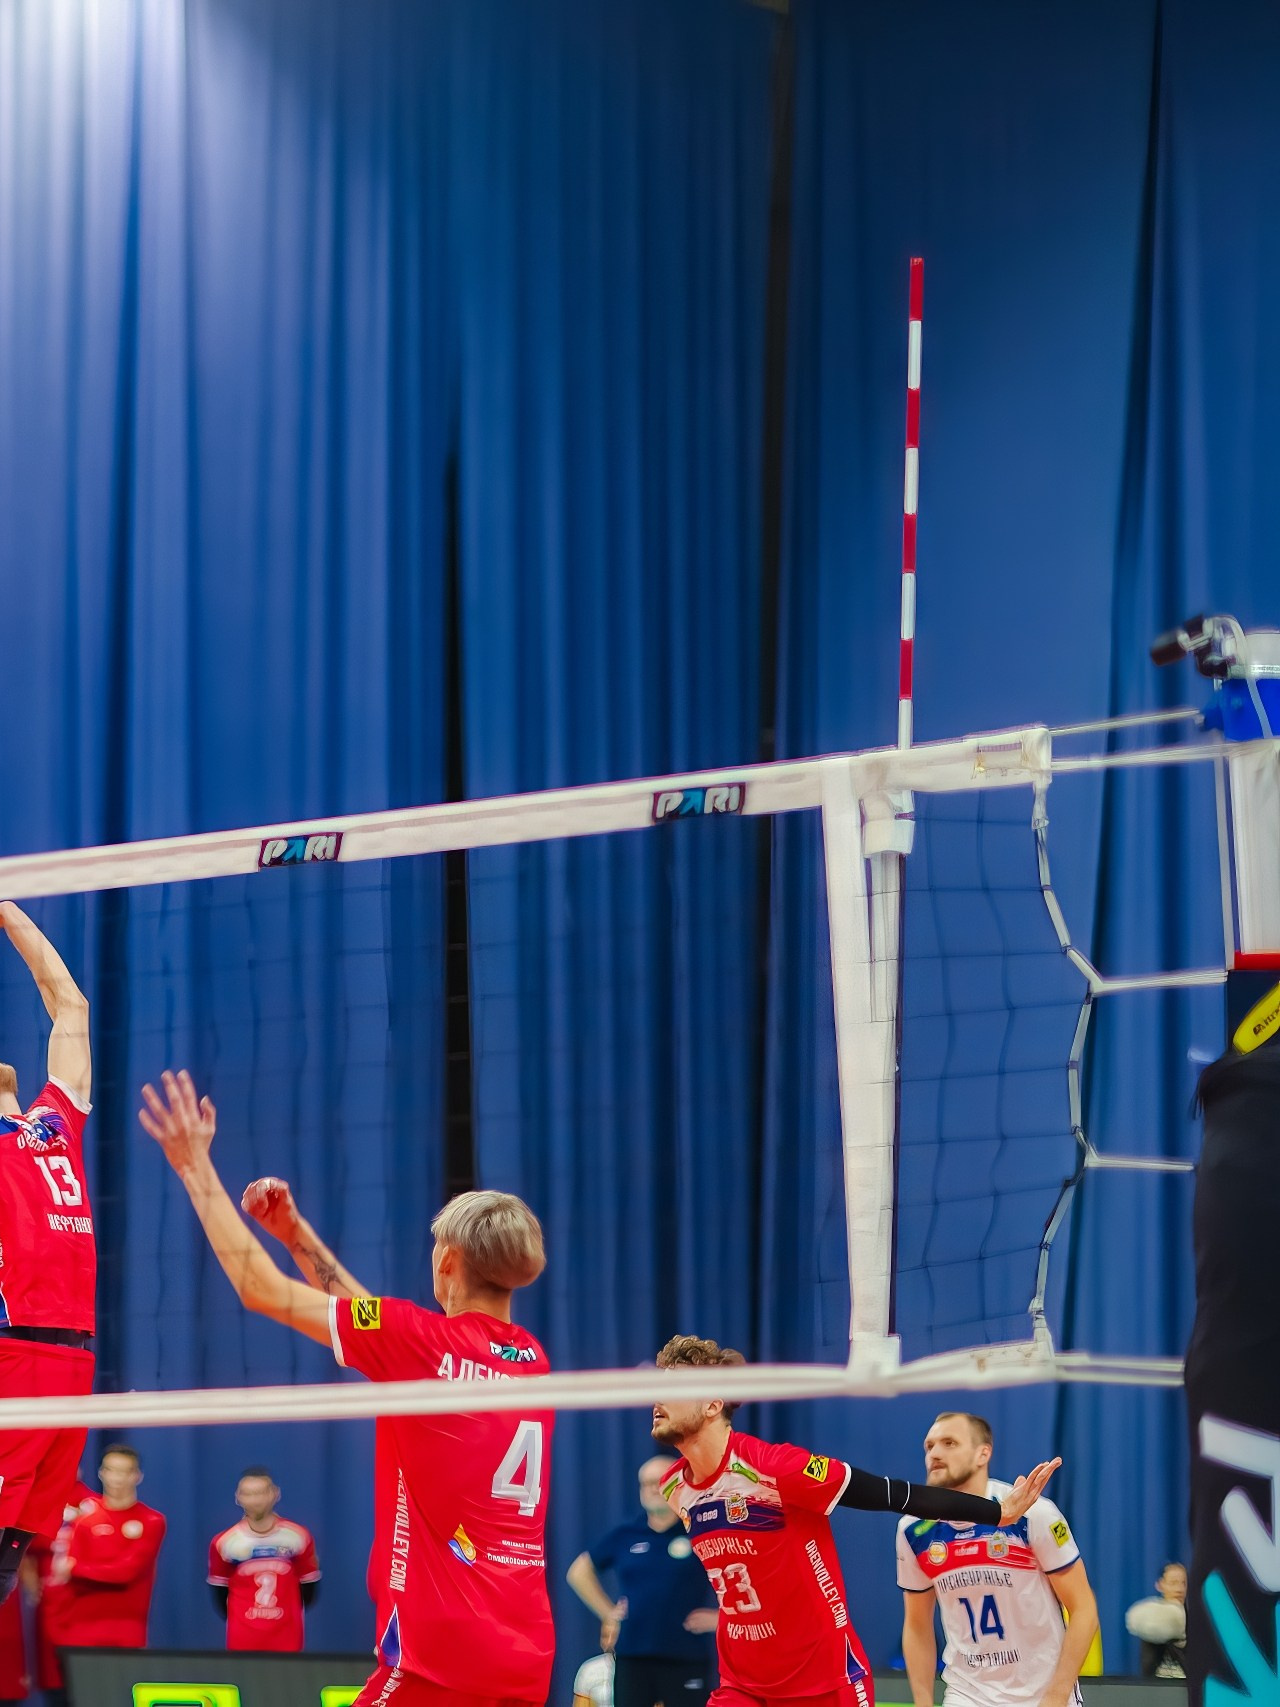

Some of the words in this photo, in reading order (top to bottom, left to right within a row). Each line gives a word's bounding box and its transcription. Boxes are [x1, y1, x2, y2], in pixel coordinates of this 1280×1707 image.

[657, 786, 740, 818] PARI
[262, 835, 339, 866] PARI
[33, 1156, 82, 1206] 13
[489, 1341, 537, 1363] PARI
[491, 1420, 542, 1517] 4
[707, 1562, 761, 1615] 23
[805, 1539, 848, 1629] ORENVOLLEY.COM
[958, 1594, 1005, 1644] 14
